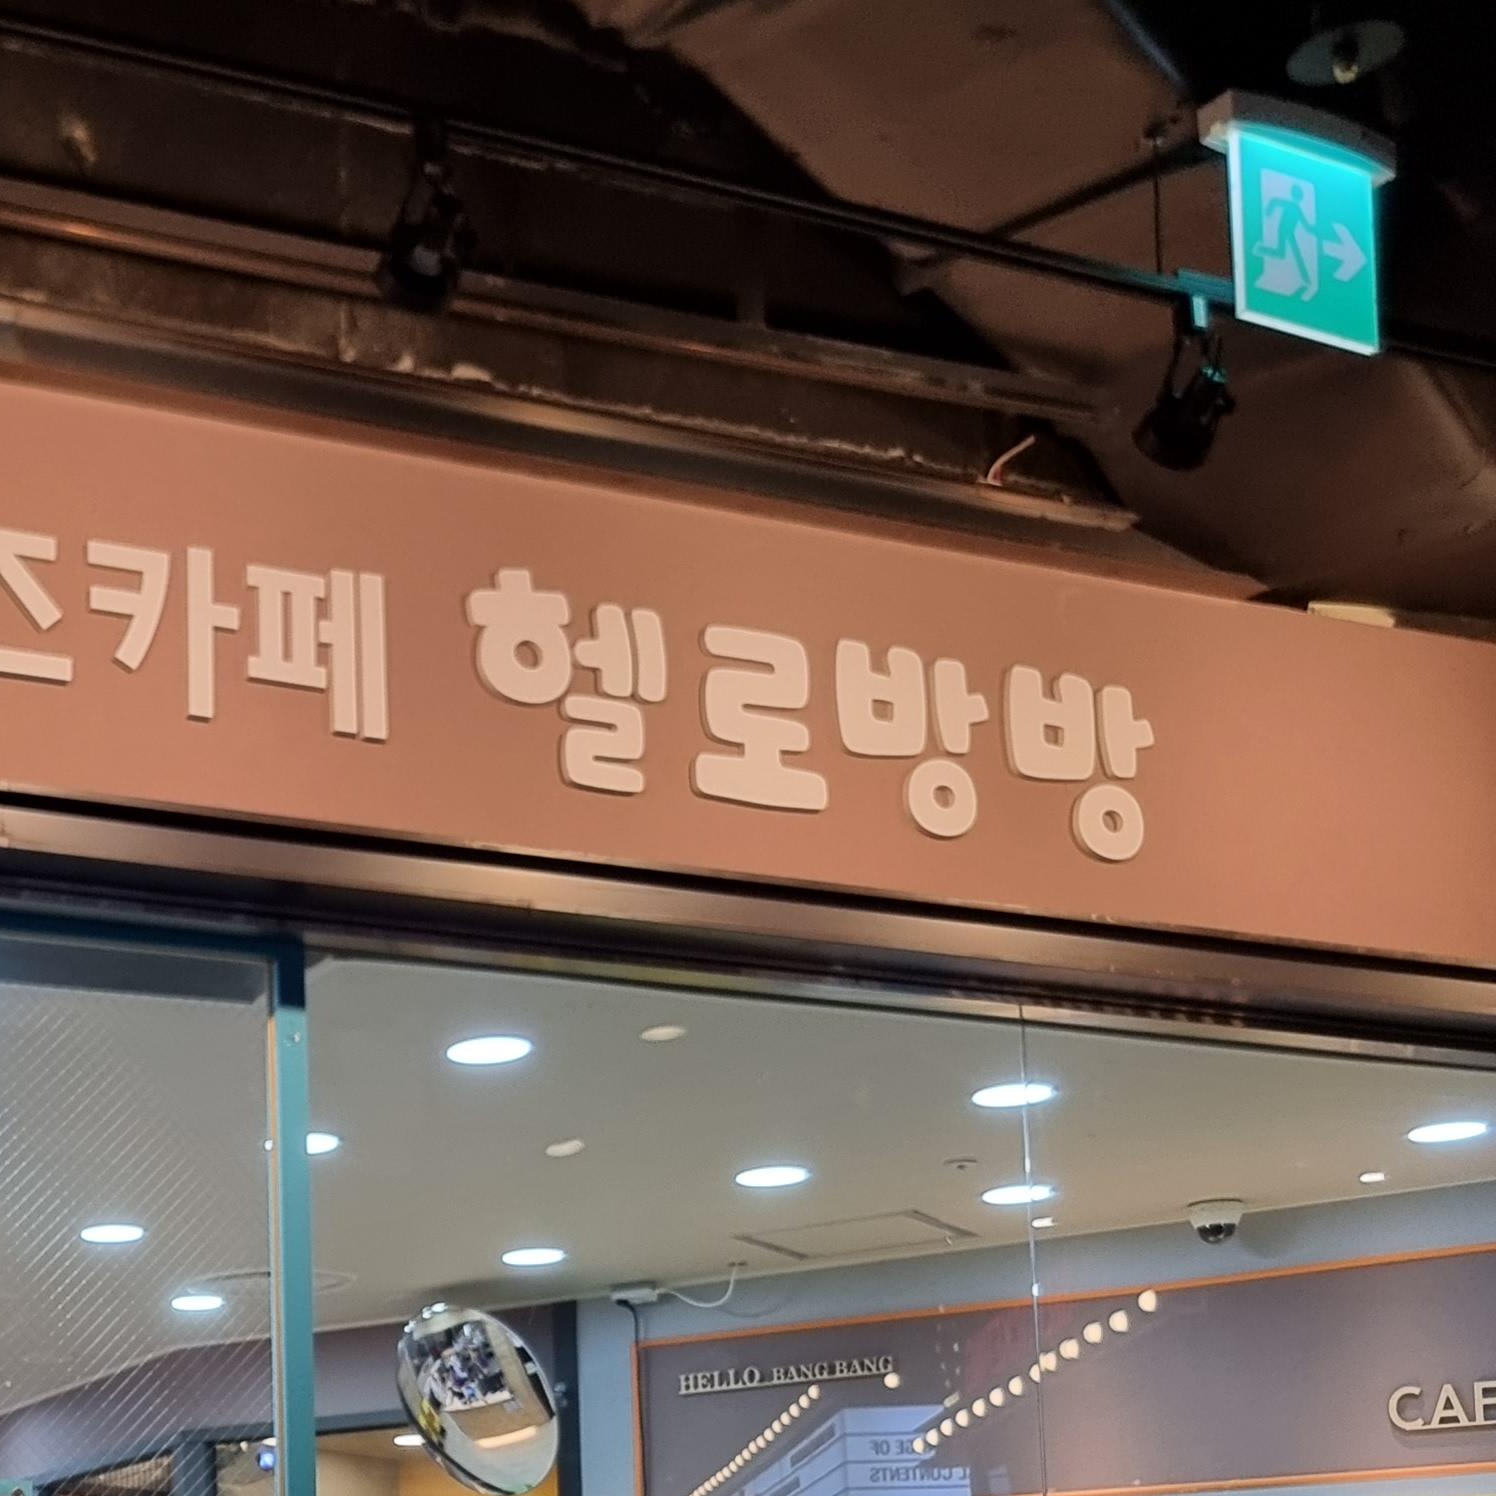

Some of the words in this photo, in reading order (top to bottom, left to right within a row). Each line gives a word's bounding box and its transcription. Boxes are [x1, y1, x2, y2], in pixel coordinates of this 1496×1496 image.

[465, 568, 1155, 863] 헬로방방
[679, 1366, 759, 1394] HELLO
[772, 1362, 828, 1384] BANG
[836, 1356, 893, 1376] BANG
